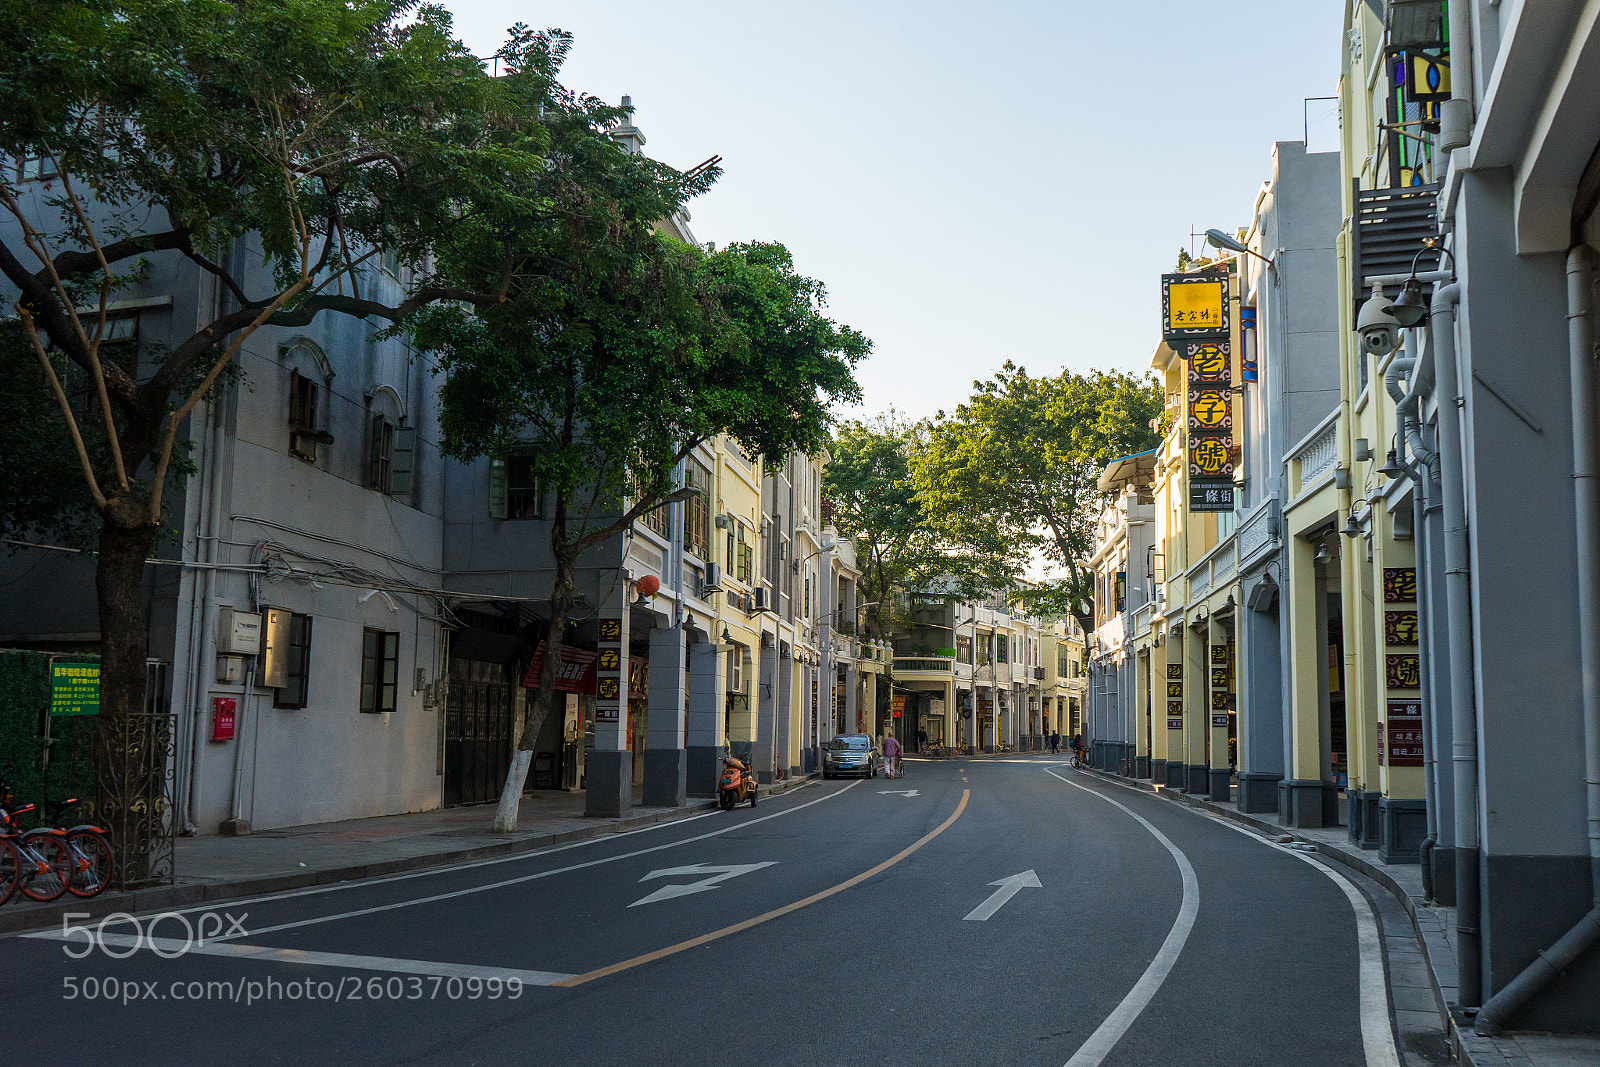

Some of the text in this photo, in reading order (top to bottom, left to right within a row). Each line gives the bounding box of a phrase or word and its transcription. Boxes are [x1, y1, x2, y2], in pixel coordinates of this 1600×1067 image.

[1193, 347, 1229, 471] 老字號
[1192, 489, 1232, 503] 一條街
